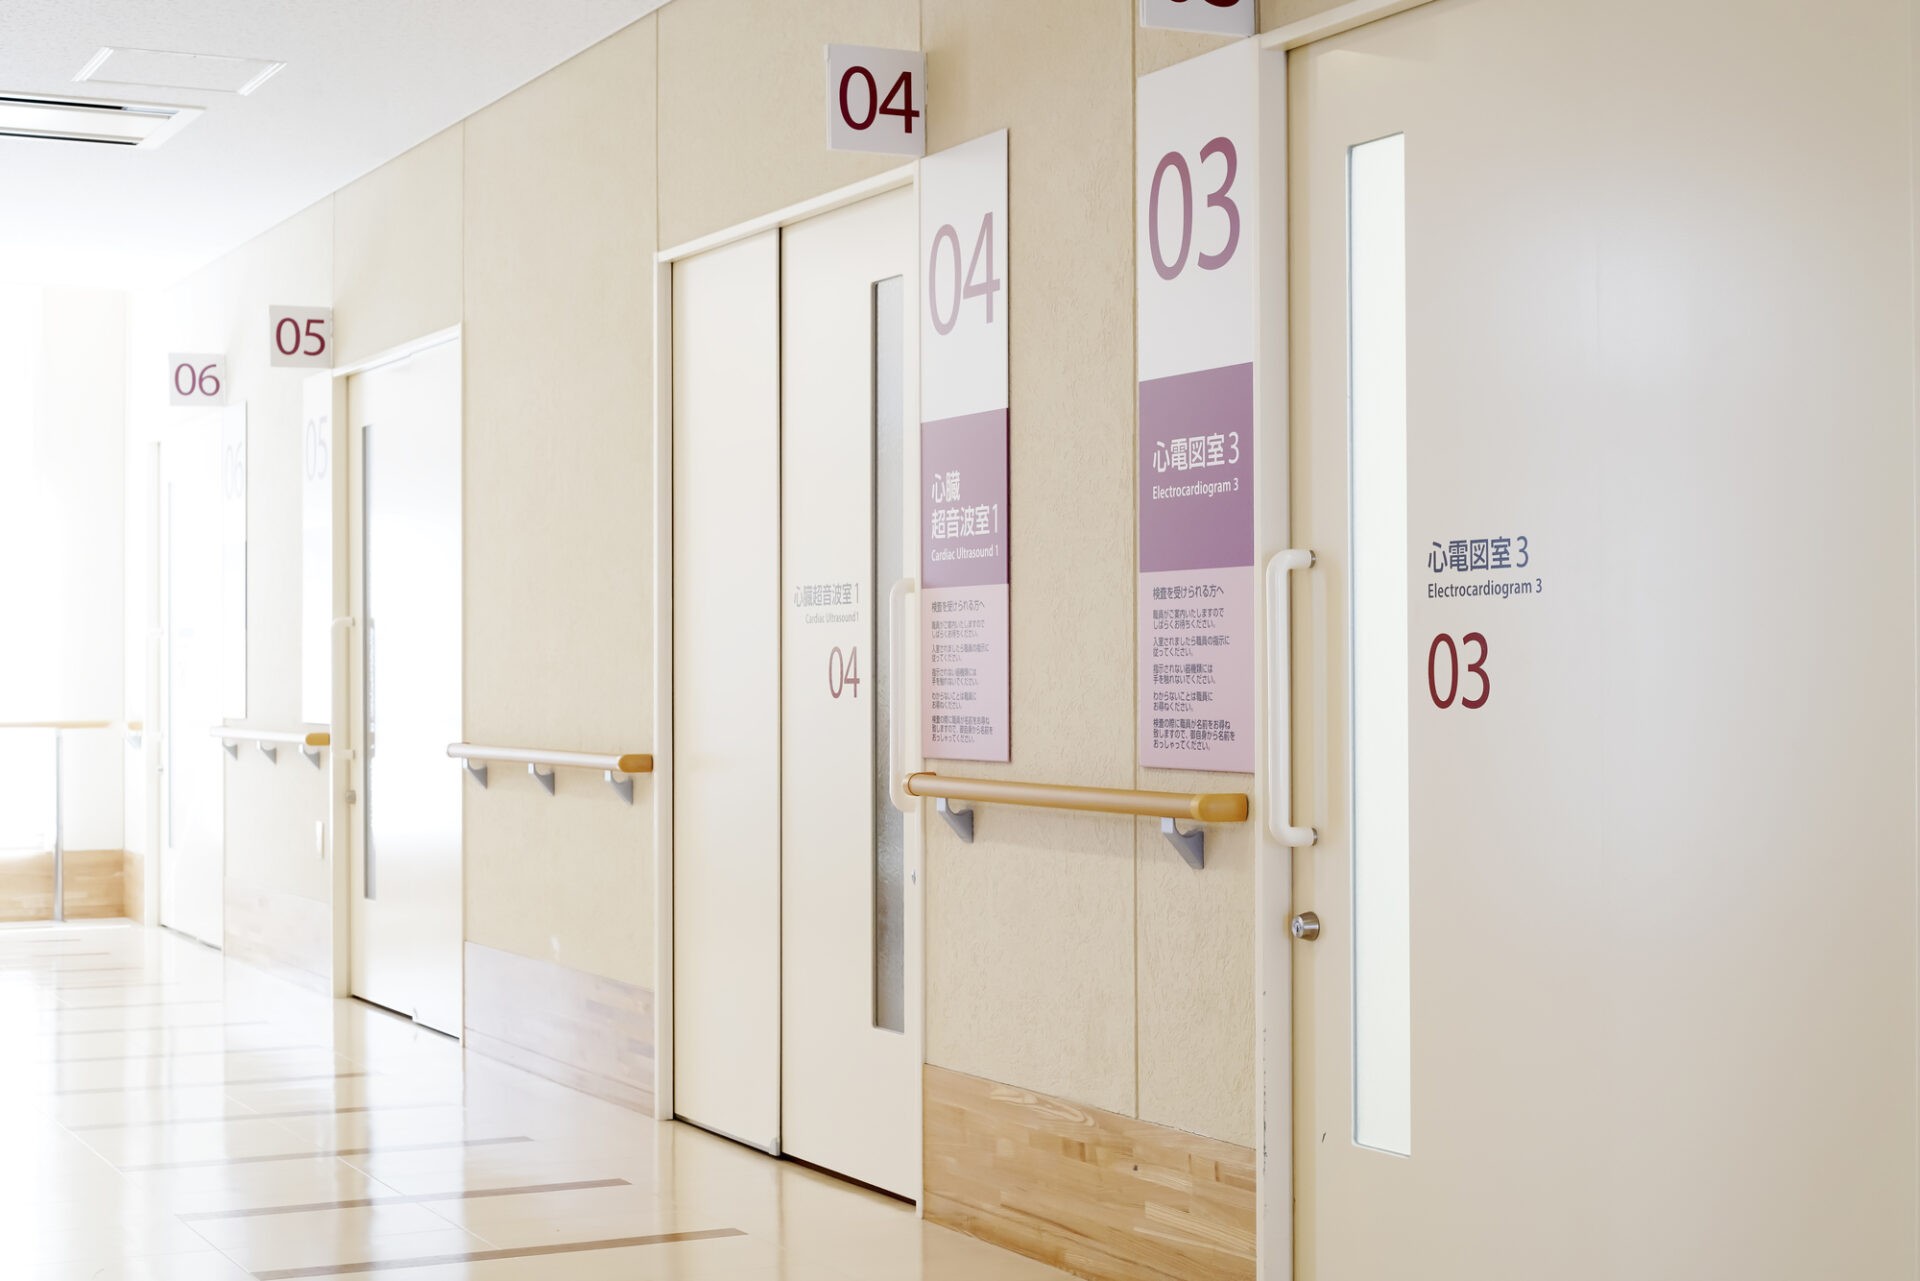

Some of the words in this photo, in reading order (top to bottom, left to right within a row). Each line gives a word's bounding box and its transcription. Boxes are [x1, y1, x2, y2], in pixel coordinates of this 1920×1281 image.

[839, 66, 920, 134] 04
[1148, 136, 1240, 281] 03
[928, 211, 1001, 336] 04
[275, 317, 326, 356] 05
[174, 363, 221, 396] 06
[305, 415, 328, 482] 05
[1152, 431, 1240, 473] 心電図室3
[931, 470, 961, 504] 心臓
[1152, 480, 1231, 499] Electrocardiogram
[1233, 477, 1239, 491] 3
[931, 503, 998, 540] 超音波室1
[931, 549, 956, 562] Cardiac
[956, 544, 994, 560] Ultrasound
[994, 544, 999, 557] 1
[1427, 535, 1529, 574] 心電図室3
[1152, 584, 1225, 601] 検査を受けられる方へ
[1427, 580, 1532, 598] Electrocardiogram
[1535, 578, 1543, 594] 3
[828, 646, 860, 699] 04
[1427, 631, 1491, 710] 03
